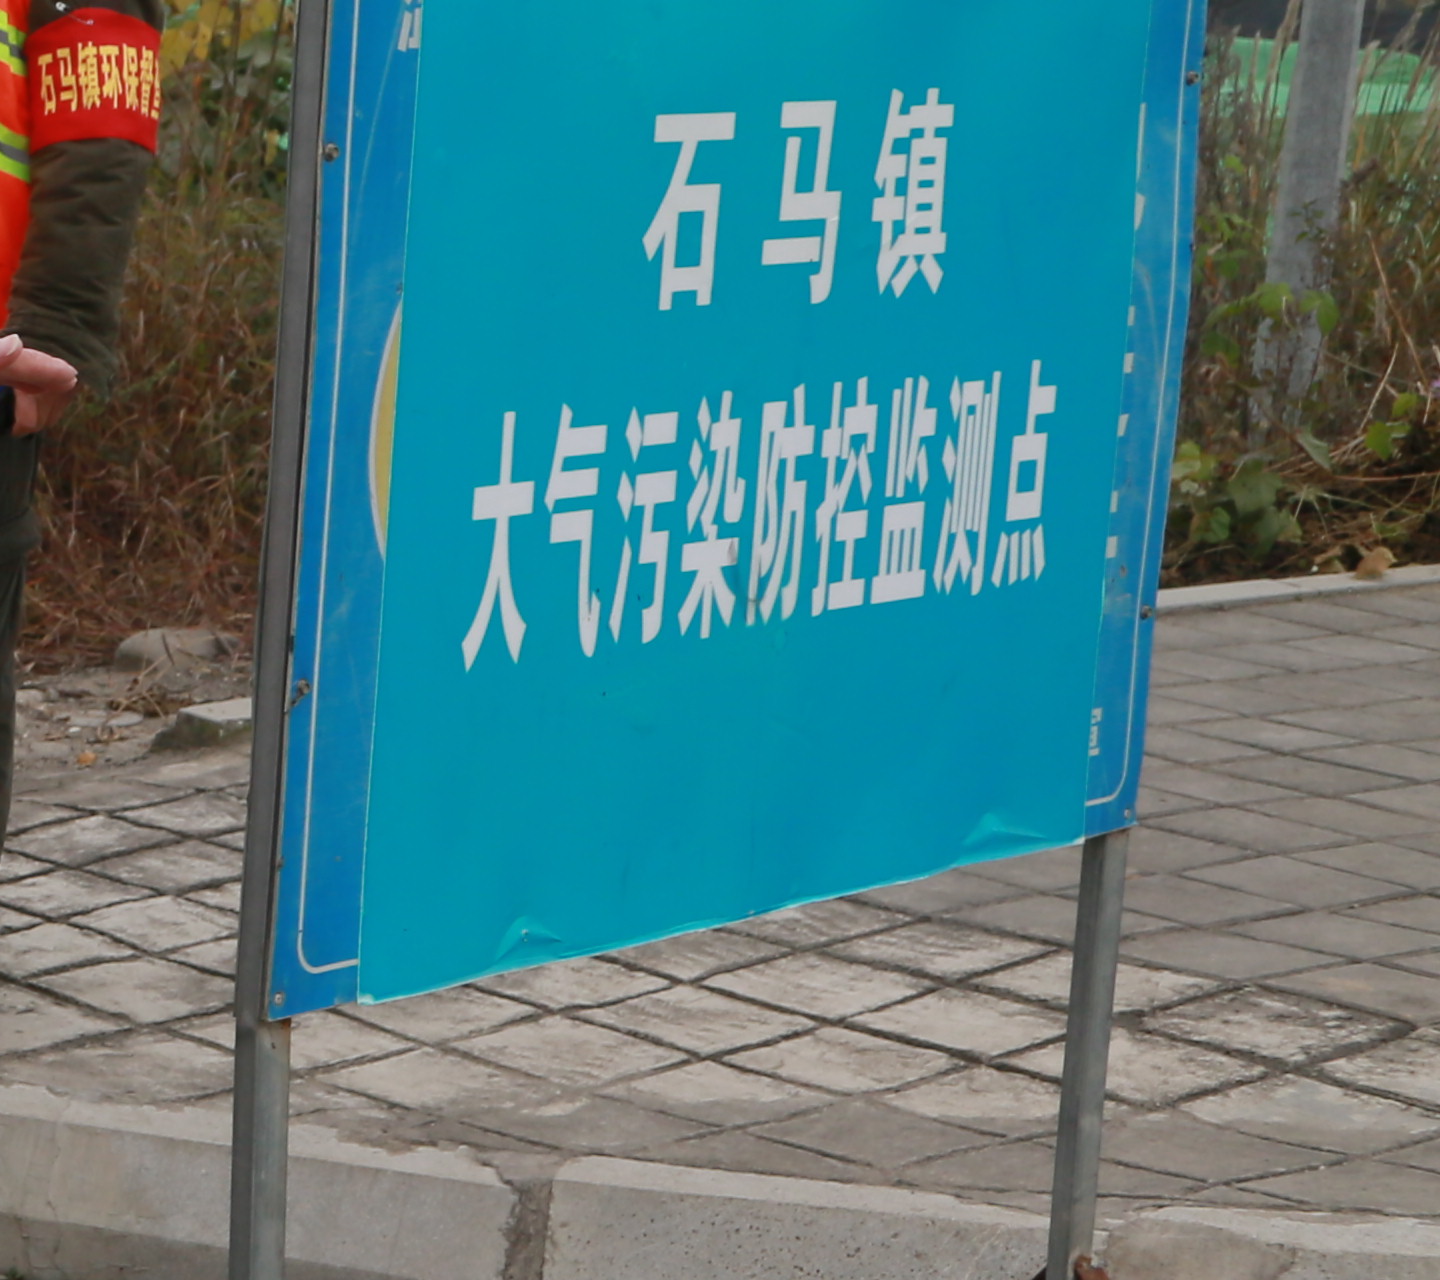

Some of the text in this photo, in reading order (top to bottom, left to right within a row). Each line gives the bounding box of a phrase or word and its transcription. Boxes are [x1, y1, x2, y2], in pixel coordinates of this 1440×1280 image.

[642, 87, 955, 311] 石马镇
[461, 358, 1058, 672] 大气污染防控监测点
